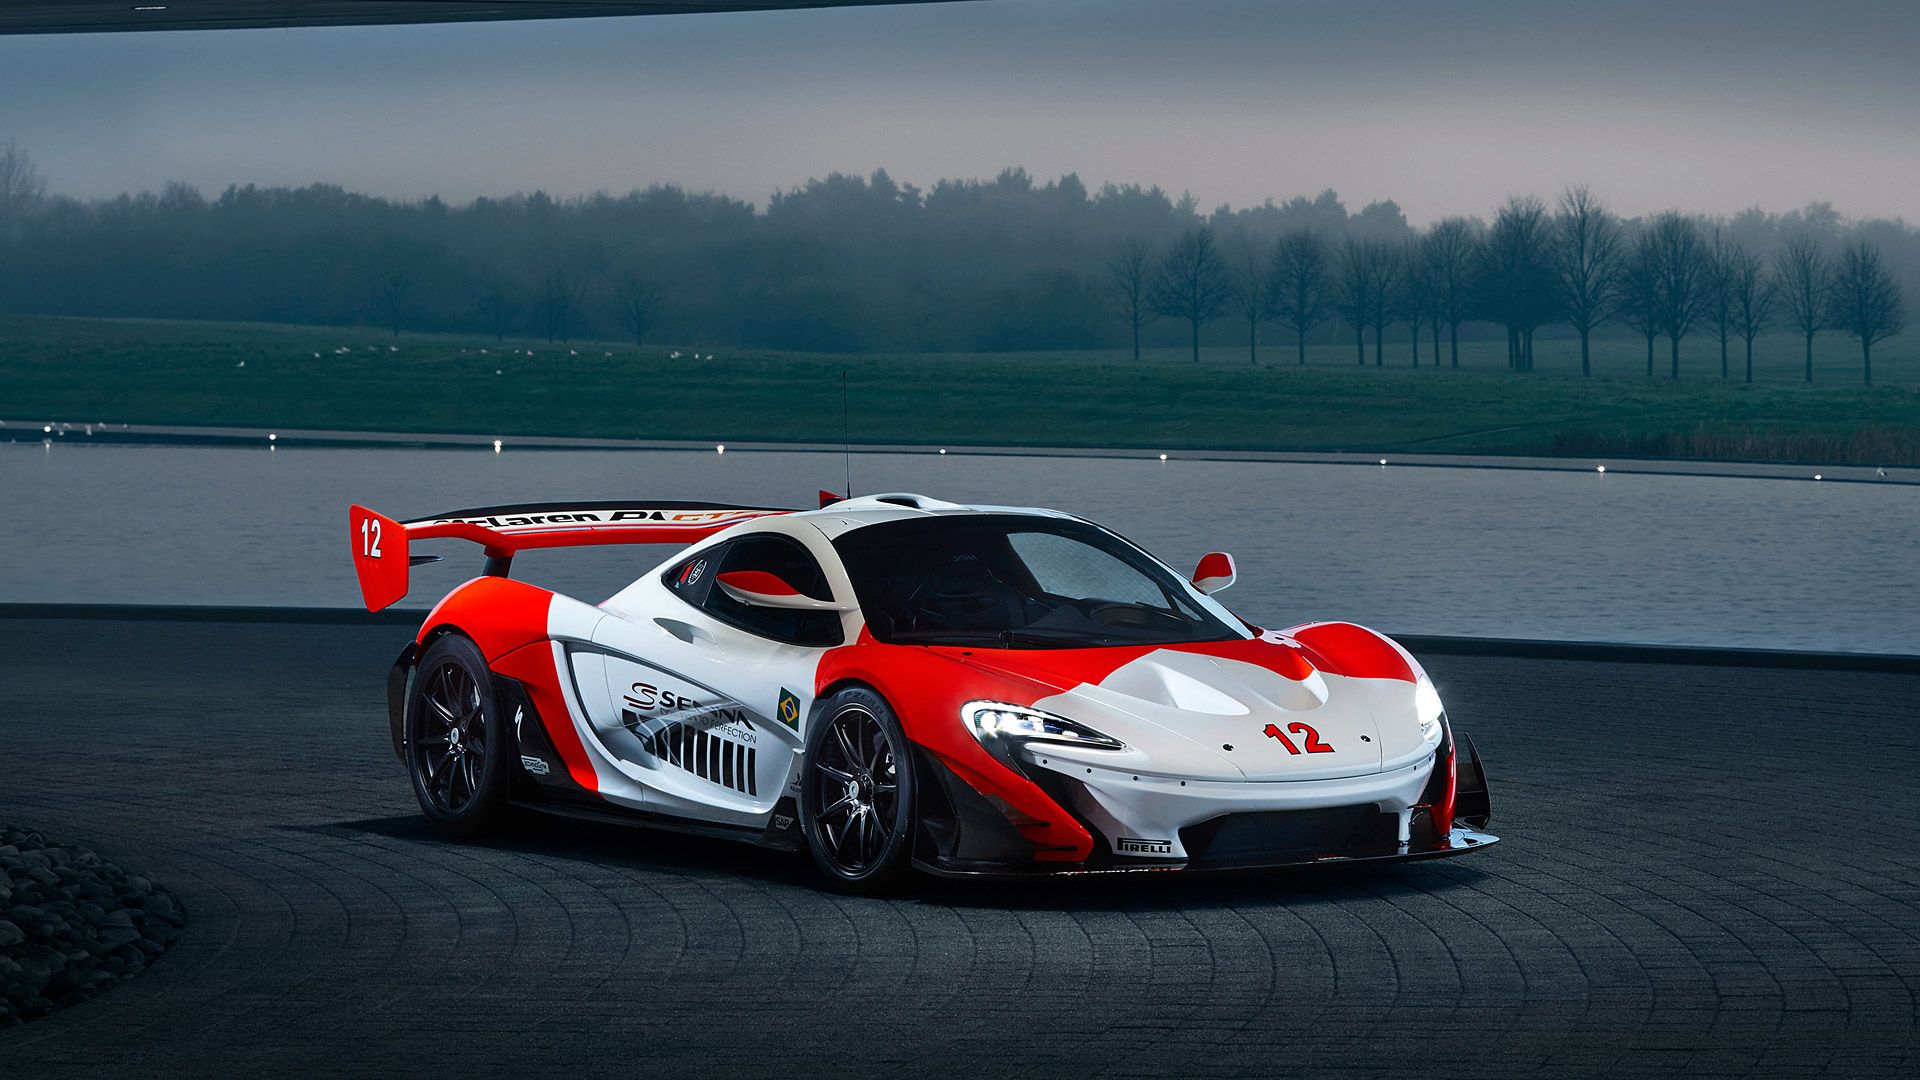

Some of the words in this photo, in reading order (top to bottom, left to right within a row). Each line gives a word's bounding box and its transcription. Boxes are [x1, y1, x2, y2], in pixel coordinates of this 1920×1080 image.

[433, 513, 601, 528] cLaren
[672, 511, 746, 521] GT
[361, 518, 382, 559] 12
[711, 720, 757, 744] PERFECTION
[1262, 722, 1336, 755] 12
[776, 815, 790, 828] SAP
[1117, 837, 1172, 854] PIRELLI
